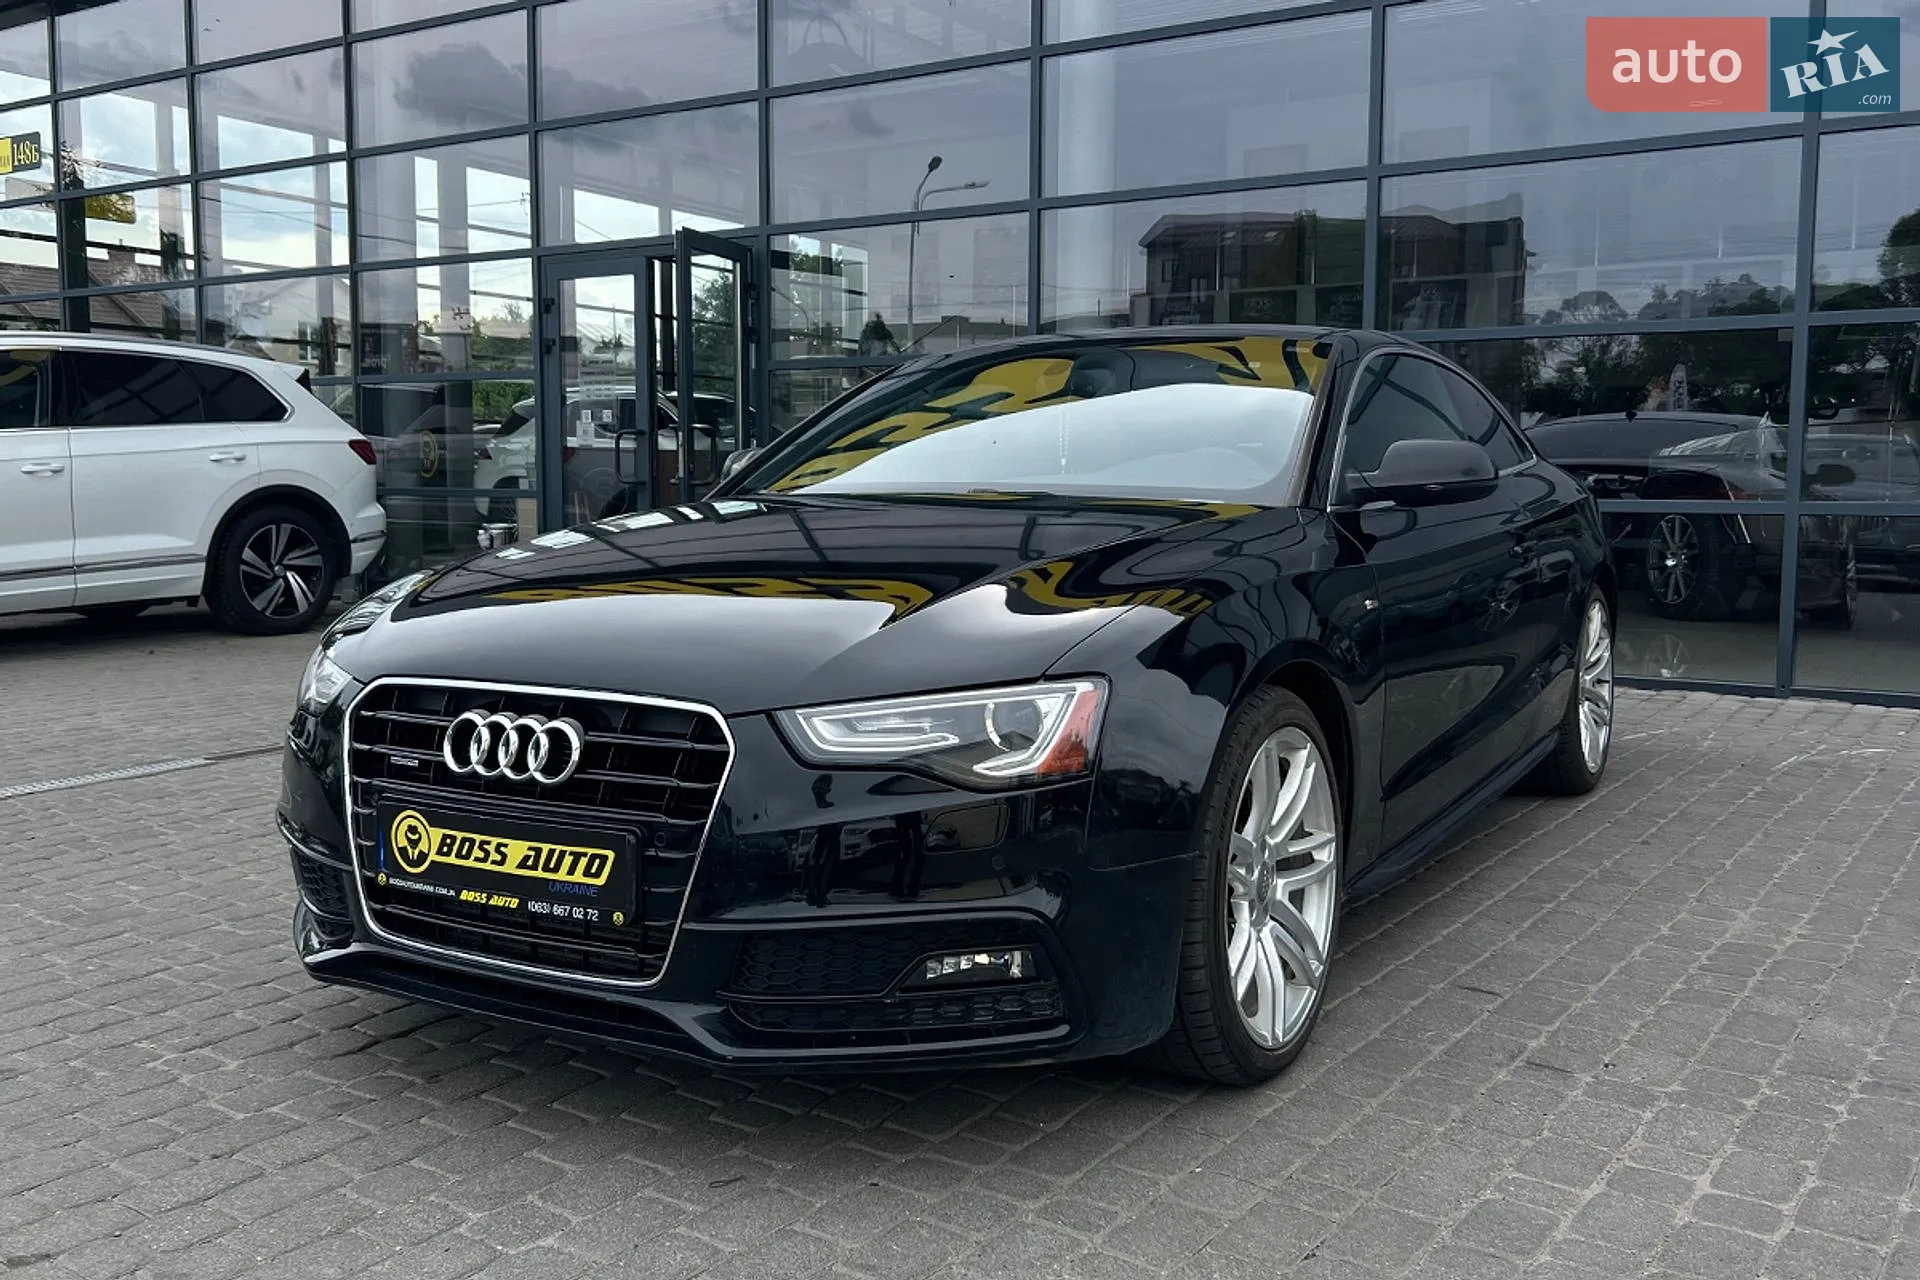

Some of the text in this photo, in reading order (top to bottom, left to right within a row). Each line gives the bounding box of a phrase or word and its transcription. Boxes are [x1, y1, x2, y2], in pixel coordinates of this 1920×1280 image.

[435, 833, 609, 879] BOSS AUTO
[549, 881, 599, 897] UKRAINE
[459, 889, 520, 909] BOSS AUTO
[552, 903, 571, 917] 667
[572, 907, 585, 919] 02
[585, 908, 600, 922] 72
